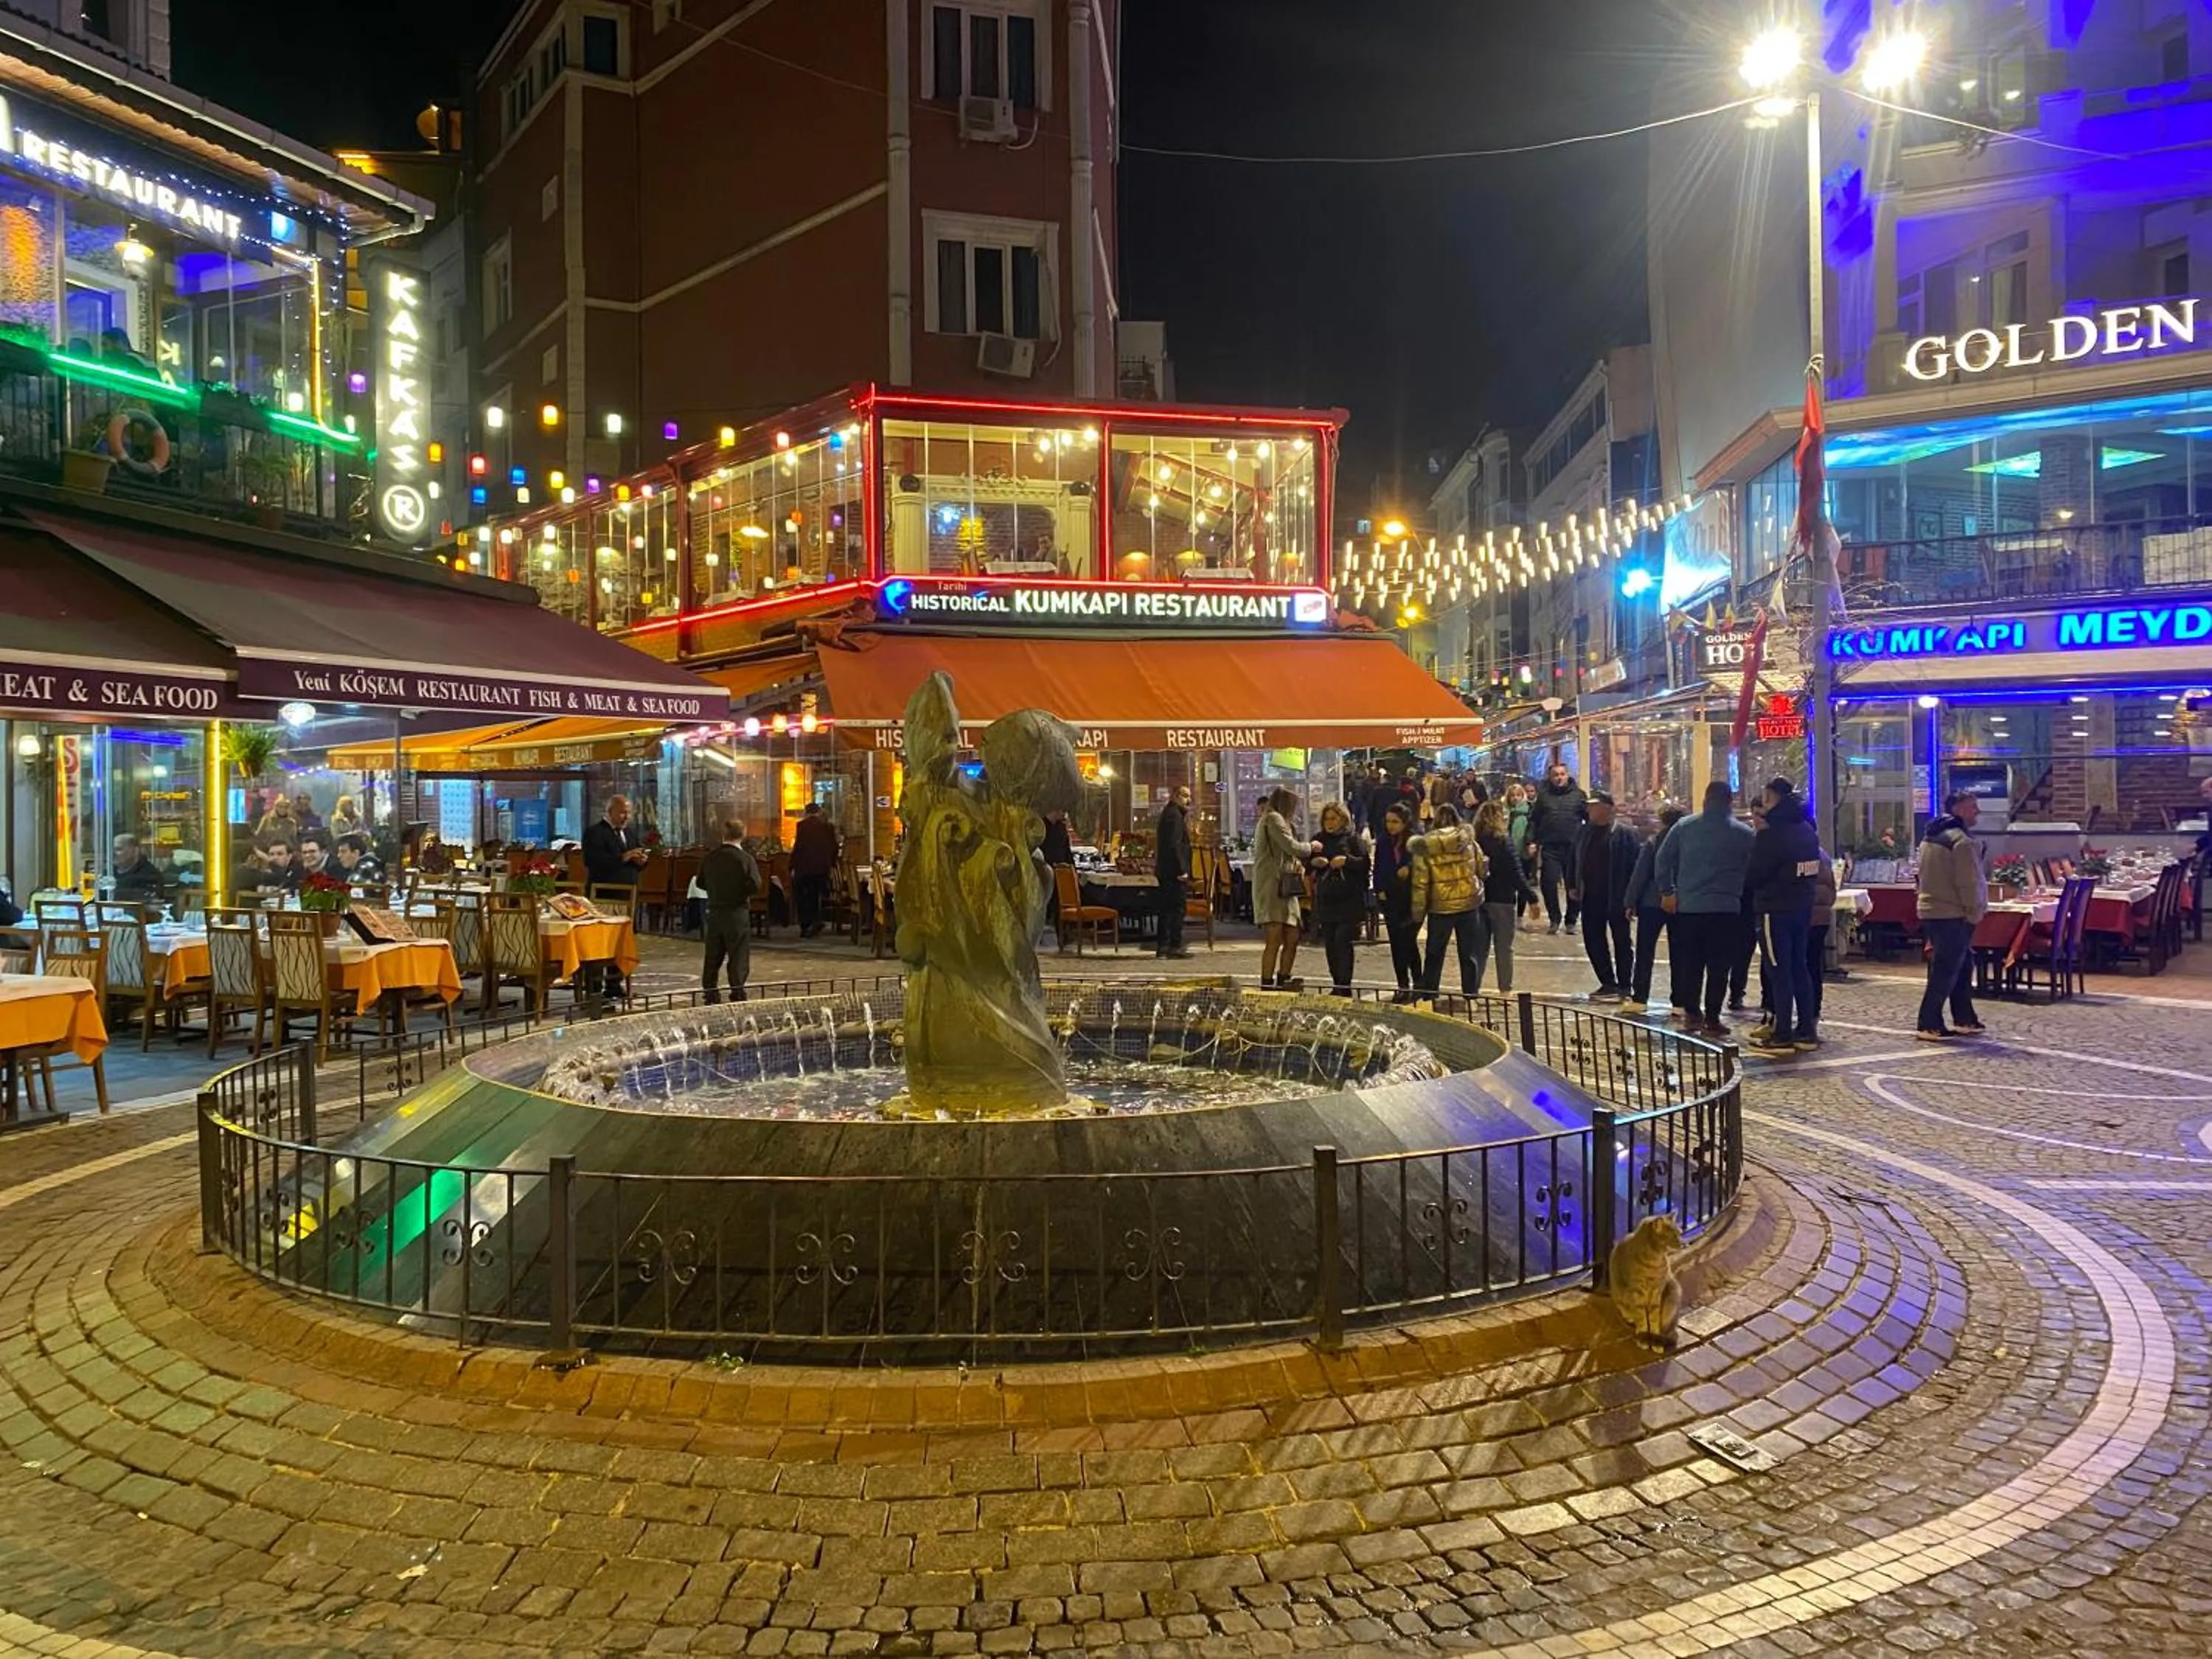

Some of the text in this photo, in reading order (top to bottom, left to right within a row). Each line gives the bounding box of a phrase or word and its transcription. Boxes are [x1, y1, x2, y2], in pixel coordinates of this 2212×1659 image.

[22, 131, 242, 239] RESTAURANT
[1904, 299, 2200, 380] GOLDEN
[388, 271, 420, 471] KAFKAS
[911, 594, 1009, 612] HISTORICAL
[1015, 590, 1127, 615] KUMKAPI
[1135, 594, 1290, 618] RESTAURANT
[1705, 632, 1753, 644] GOLDEN
[2060, 607, 2212, 645] MEYD
[0, 672, 56, 700] EAT
[68, 679, 89, 701] &
[294, 670, 330, 691] Yeni
[339, 669, 406, 699] KÖŞEM
[417, 679, 521, 706] RESTAURANT
[529, 689, 562, 708] FISH
[567, 692, 579, 709] &
[584, 693, 621, 711] MEAT
[627, 696, 638, 712] &
[1166, 729, 1265, 748] RESTAURANT
